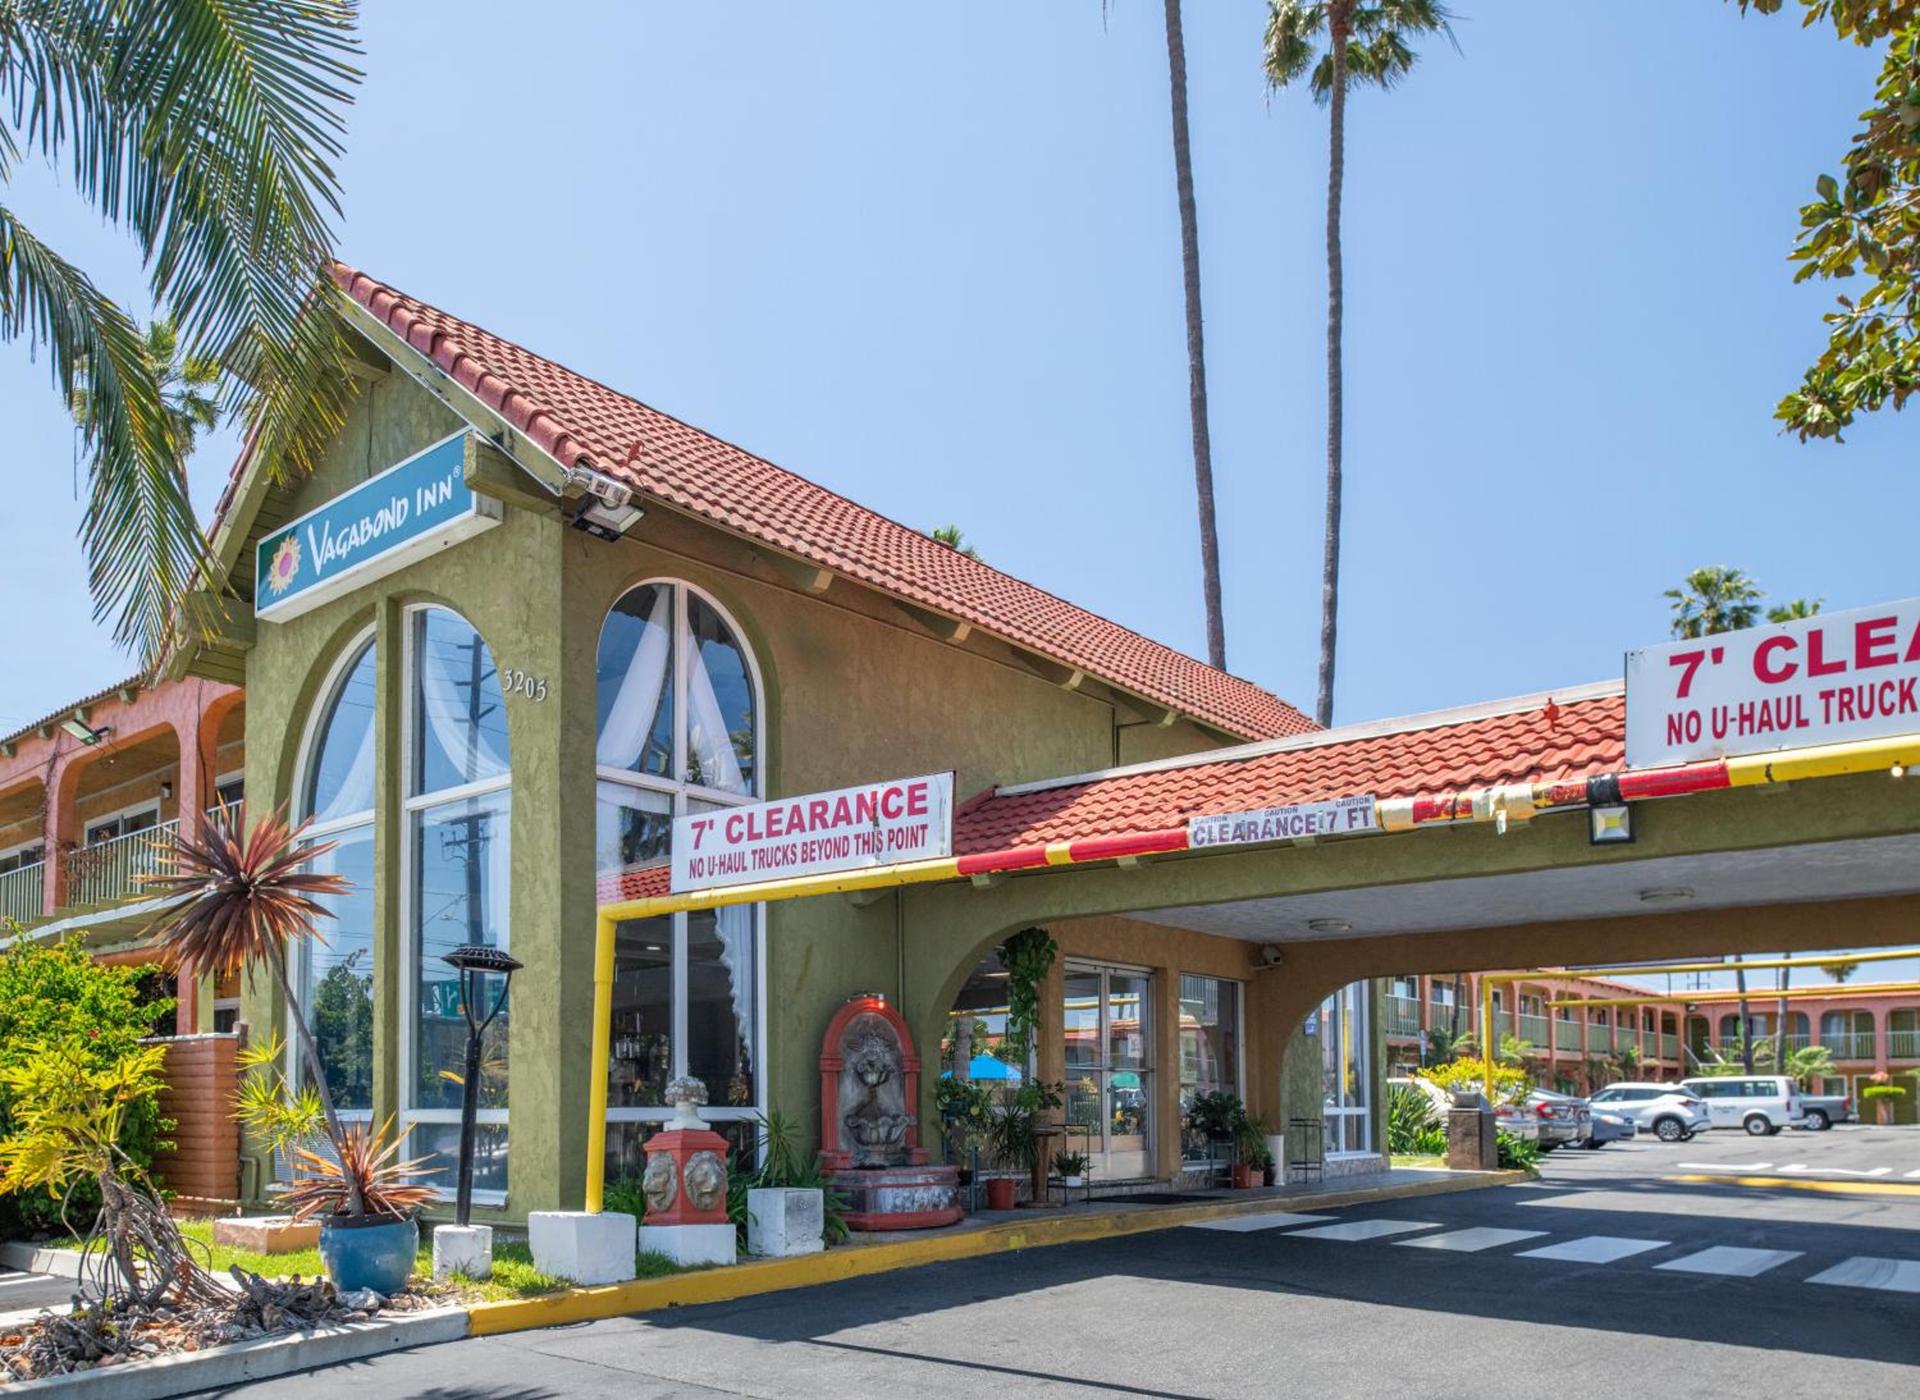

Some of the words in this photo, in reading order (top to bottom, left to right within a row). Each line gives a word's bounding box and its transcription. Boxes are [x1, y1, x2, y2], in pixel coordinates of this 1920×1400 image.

[308, 496, 409, 576] VAGABOND
[502, 669, 547, 702] 3205
[1669, 647, 1724, 698] 7'
[1667, 710, 1702, 746] NO
[1711, 694, 1809, 740] U-HAUL
[691, 819, 714, 850] 7'
[725, 783, 928, 844] CLEARANCE
[1193, 814, 1317, 846] CLEARANCE
[1326, 811, 1338, 830] 7
[1347, 806, 1371, 829] FT
[1264, 807, 1299, 817] CAUTION
[1335, 796, 1371, 808] CAUTION
[689, 857, 704, 879] NO
[708, 853, 747, 877] U-HAUL
[751, 843, 797, 871] TRUCKS
[801, 835, 850, 863] BEYOND
[853, 830, 883, 856] THIS
[887, 824, 928, 851] POINT
